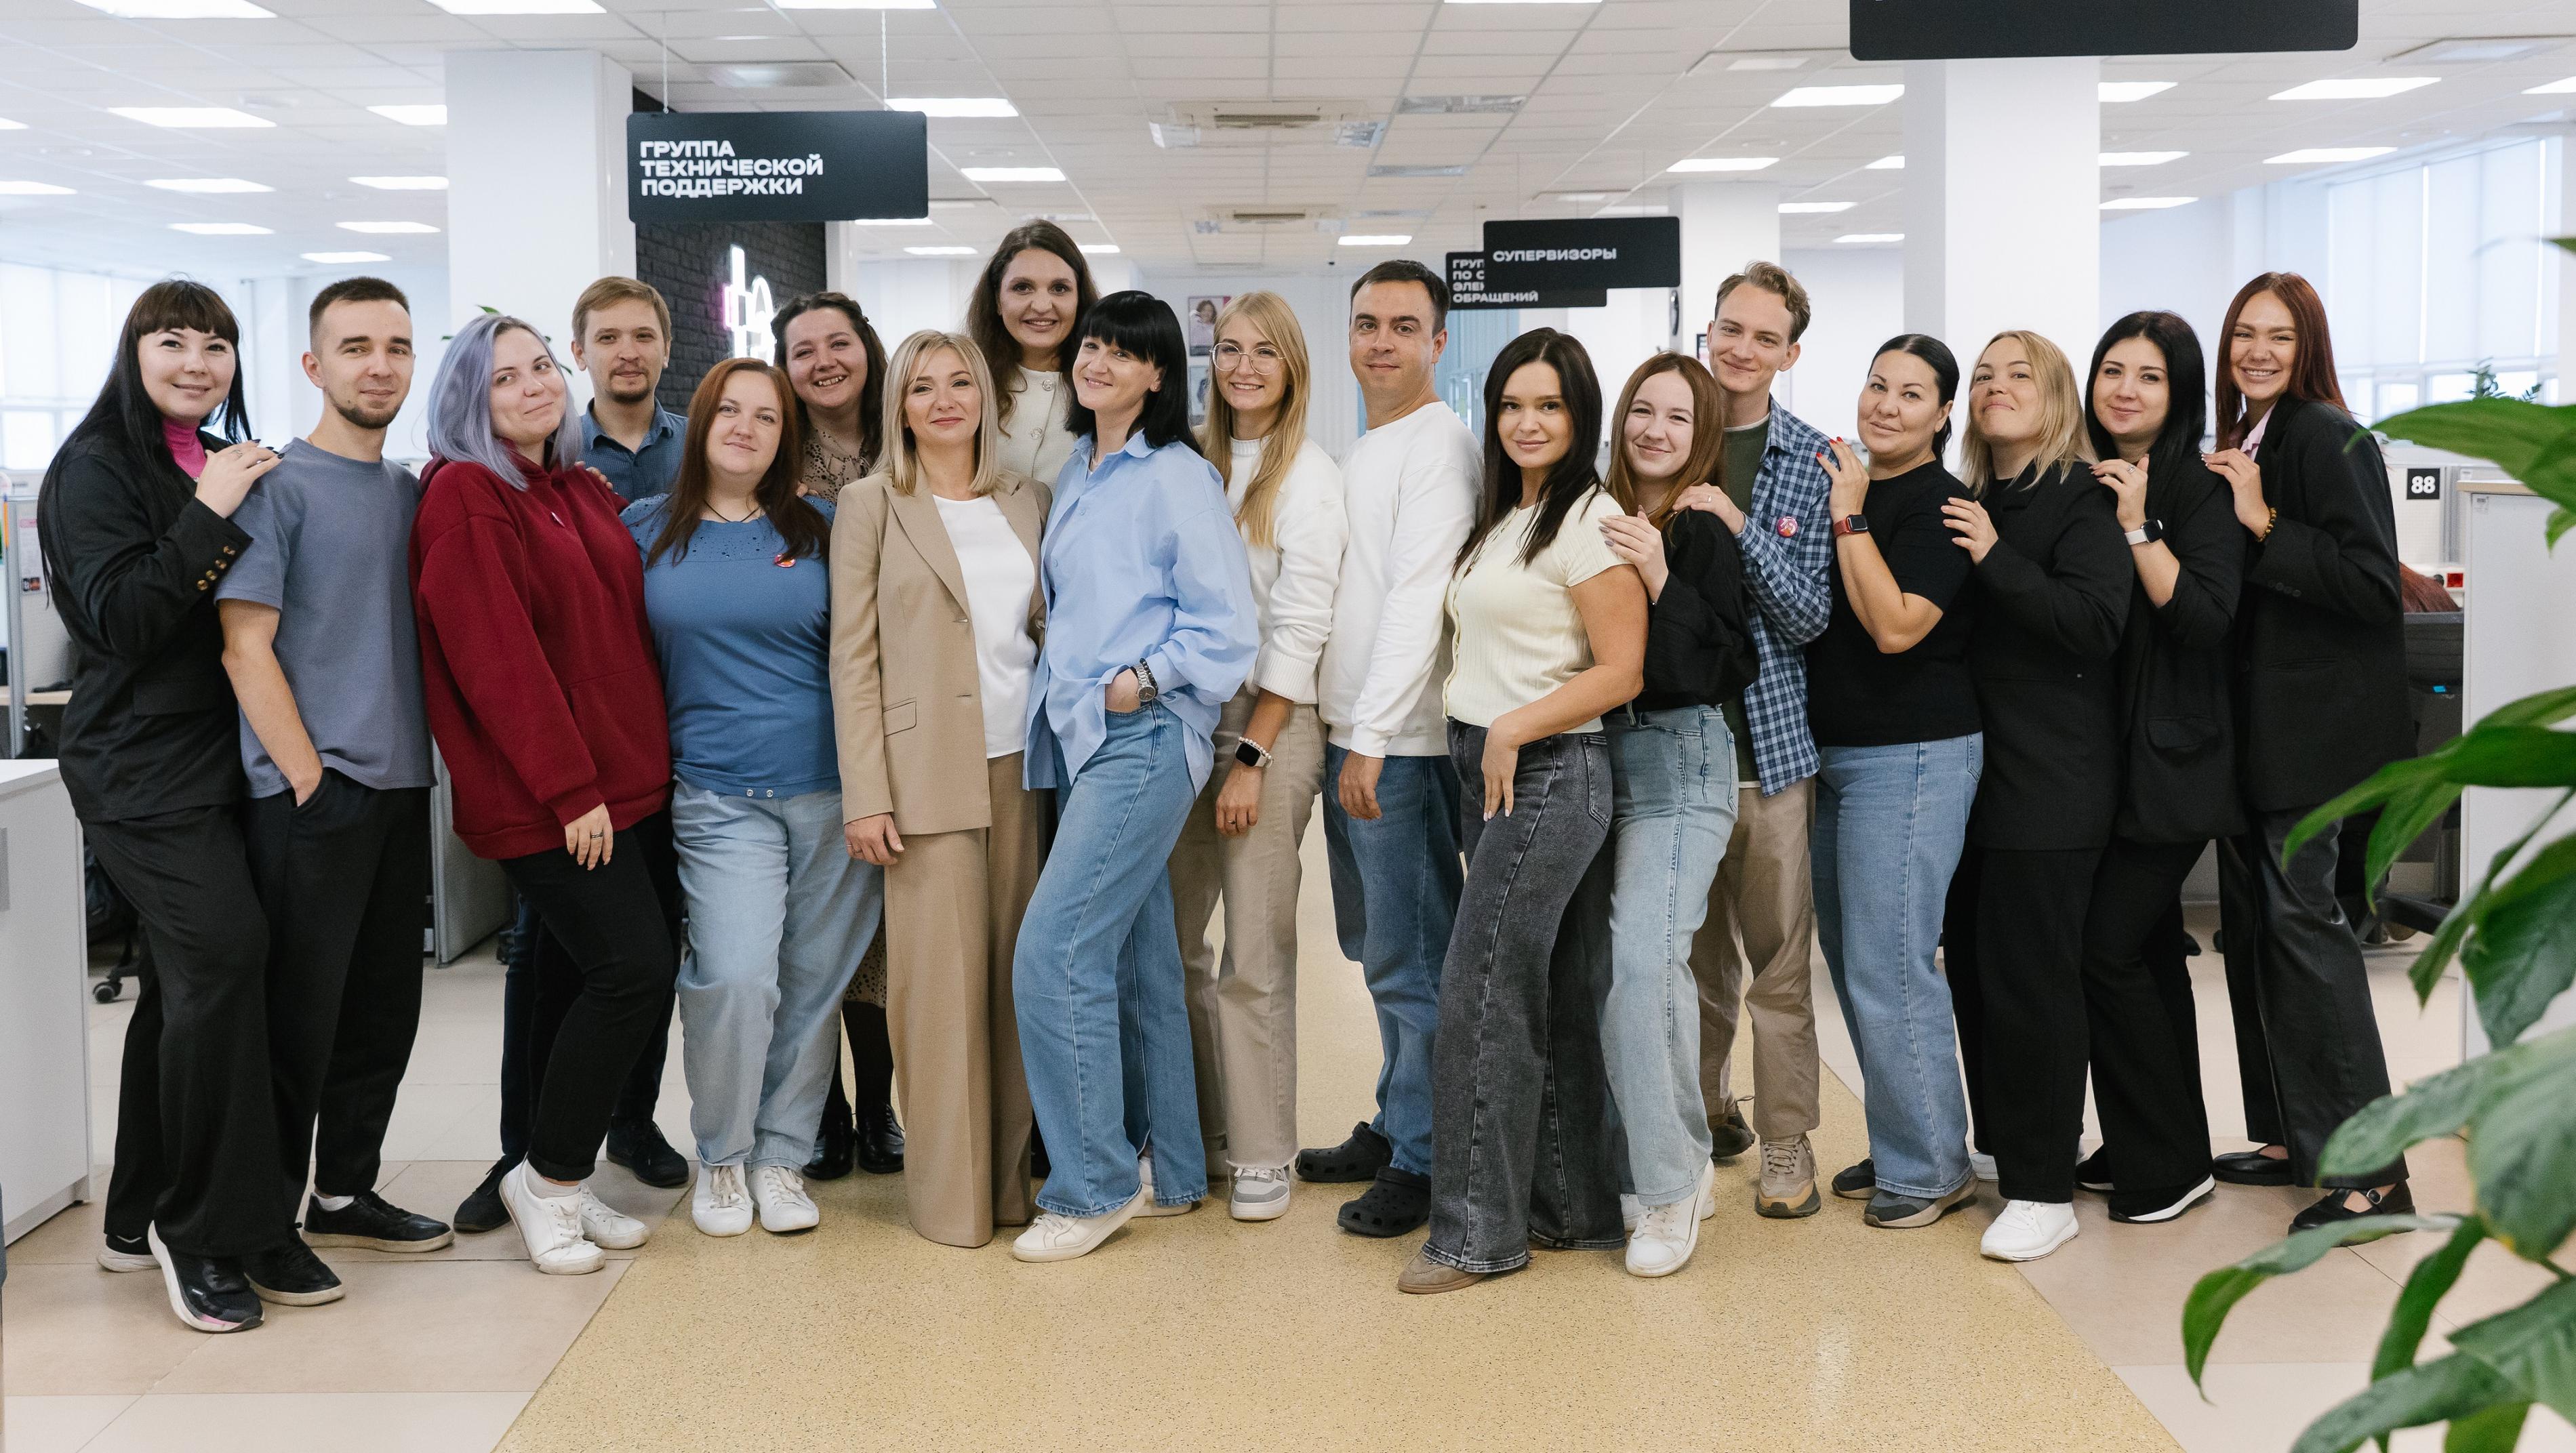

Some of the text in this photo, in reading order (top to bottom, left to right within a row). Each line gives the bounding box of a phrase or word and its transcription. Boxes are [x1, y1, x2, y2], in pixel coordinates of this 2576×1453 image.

[640, 140, 736, 158] ГРУППА
[640, 154, 824, 176] ТЕХНИЧЕСКОЙ
[641, 178, 803, 198] ПОДДЕРЖКИ
[1493, 248, 1617, 262] СУПЕРВИЗОРЫ
[1453, 270, 1472, 280] ПО
[1453, 290, 1539, 304] ОБРАЩЕНИЙ
[2411, 476, 2436, 494] 88
